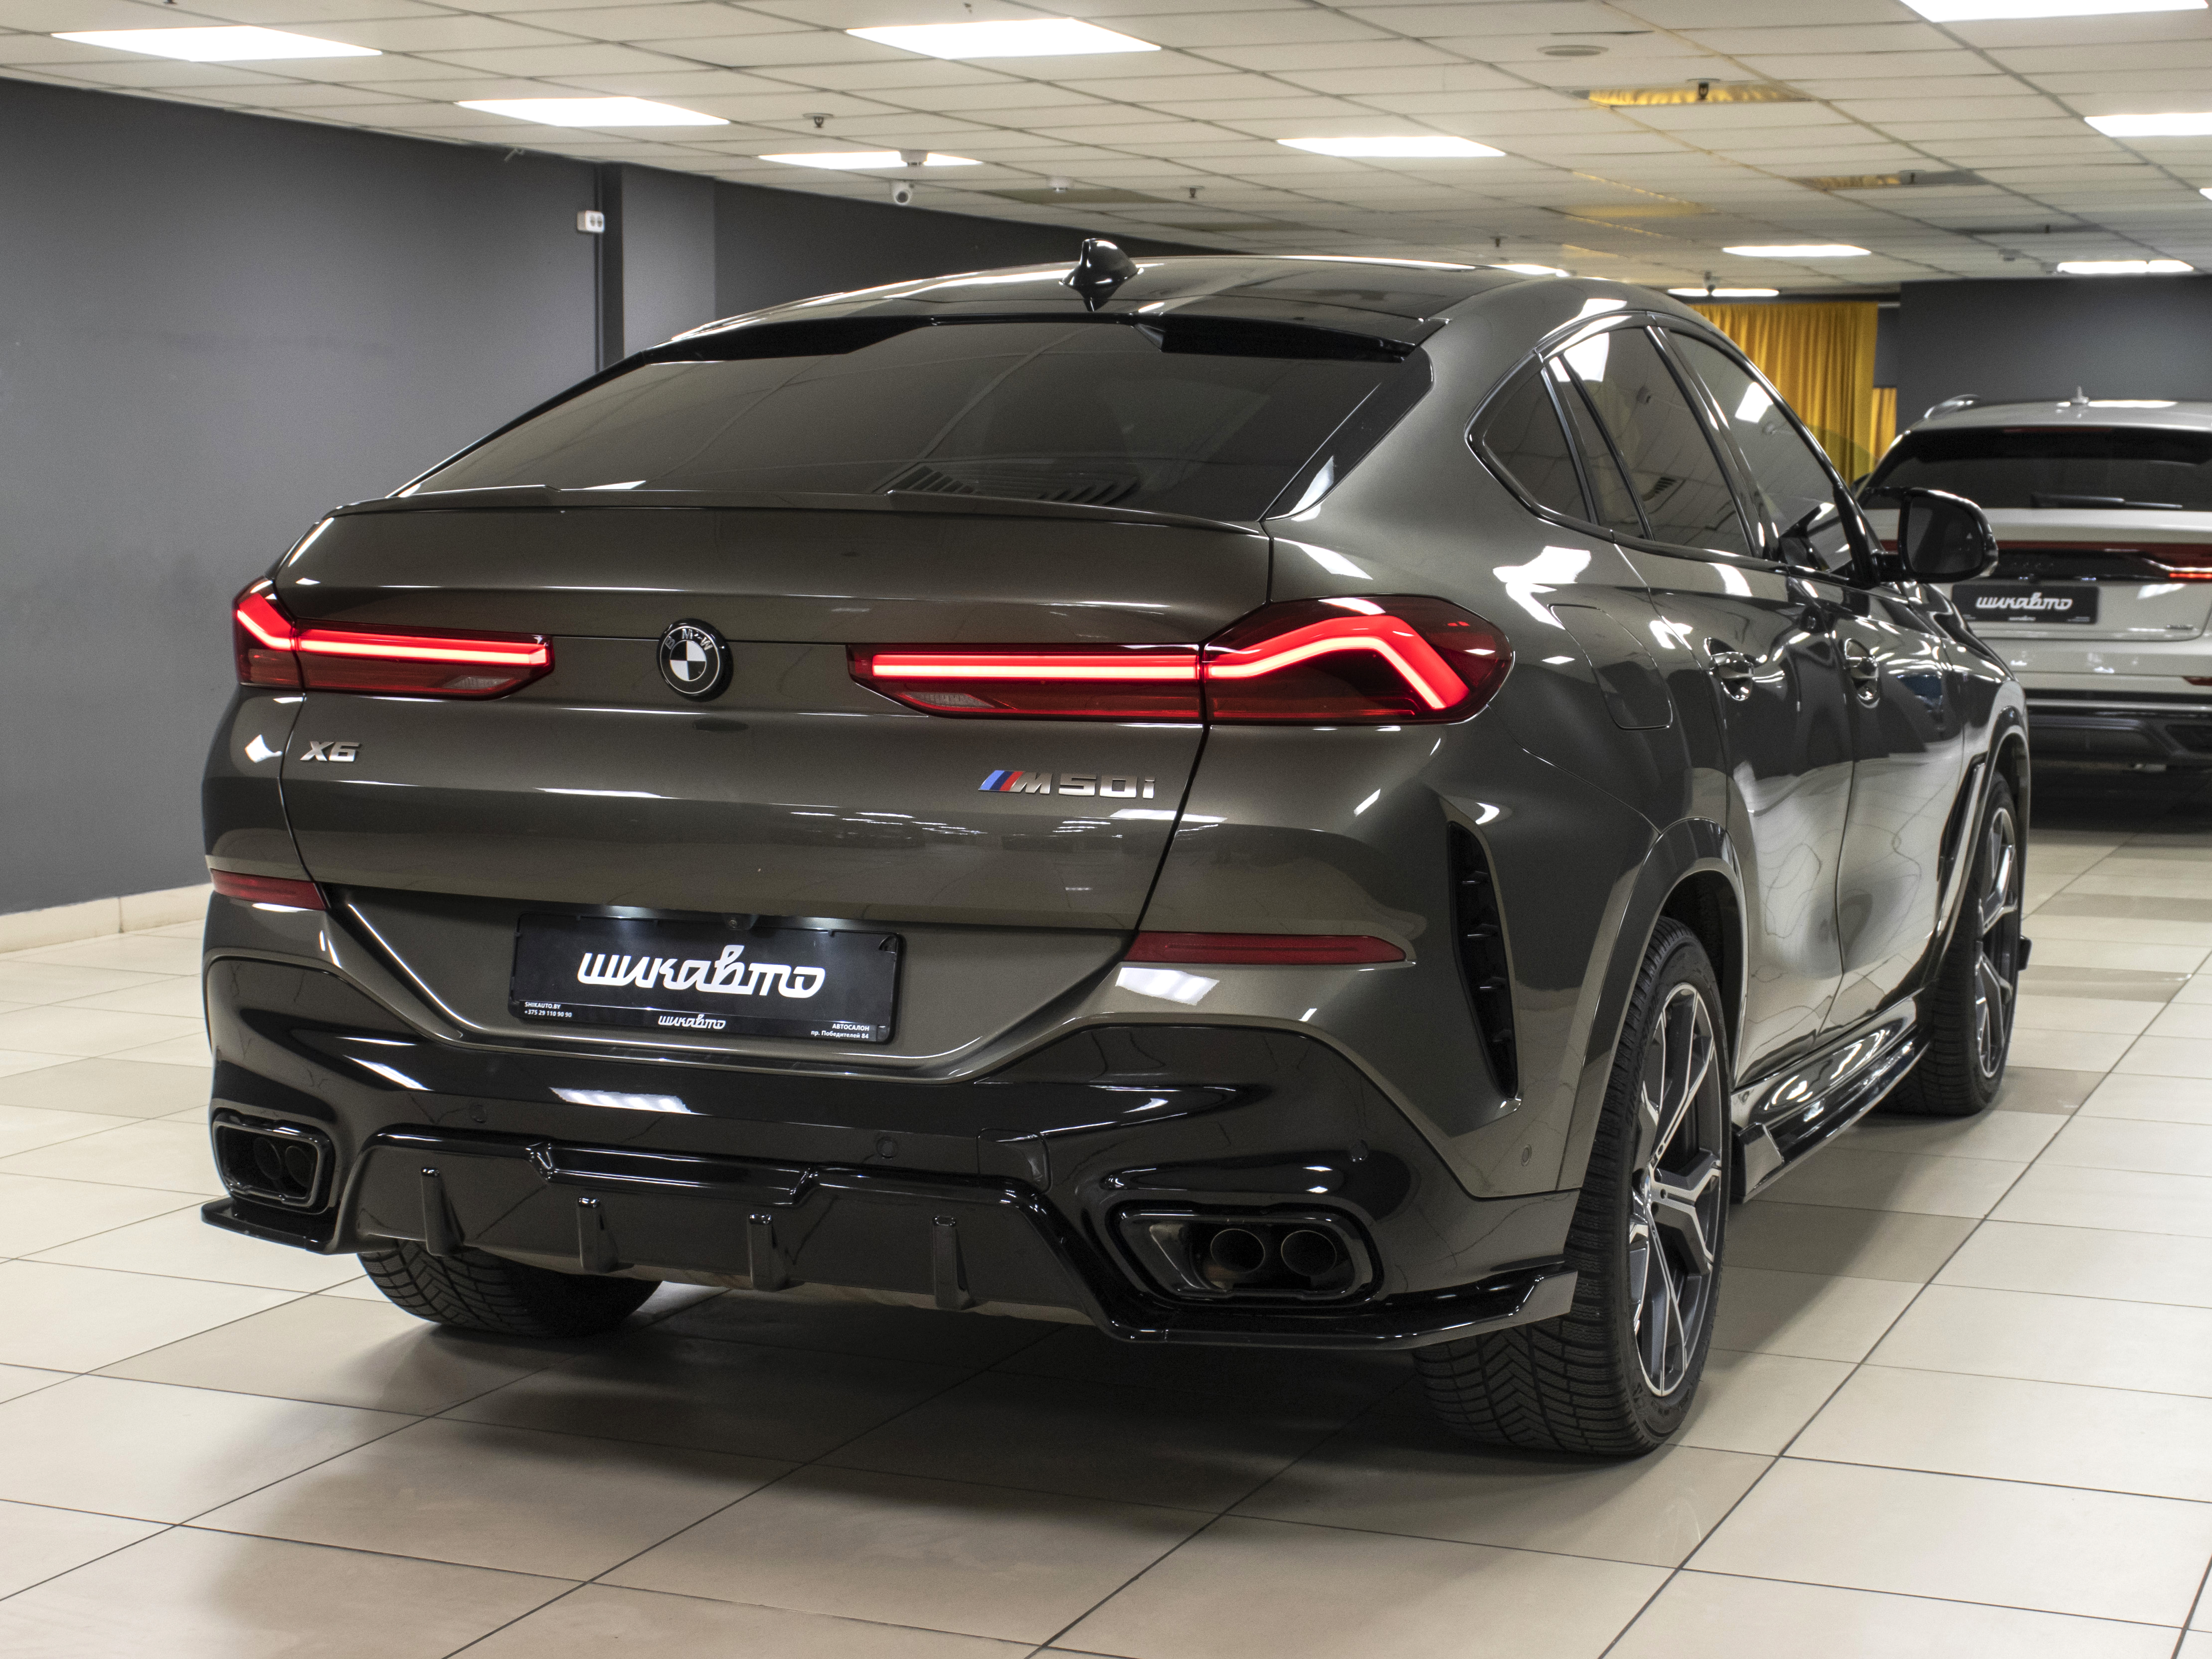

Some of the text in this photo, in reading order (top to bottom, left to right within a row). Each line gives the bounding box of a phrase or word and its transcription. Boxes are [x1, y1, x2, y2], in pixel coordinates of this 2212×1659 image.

[1976, 592, 2073, 610] шикавто
[665, 629, 713, 651] BMW
[300, 741, 362, 762] X6
[577, 945, 826, 998] шикавто
[658, 1014, 726, 1029] шикавто
